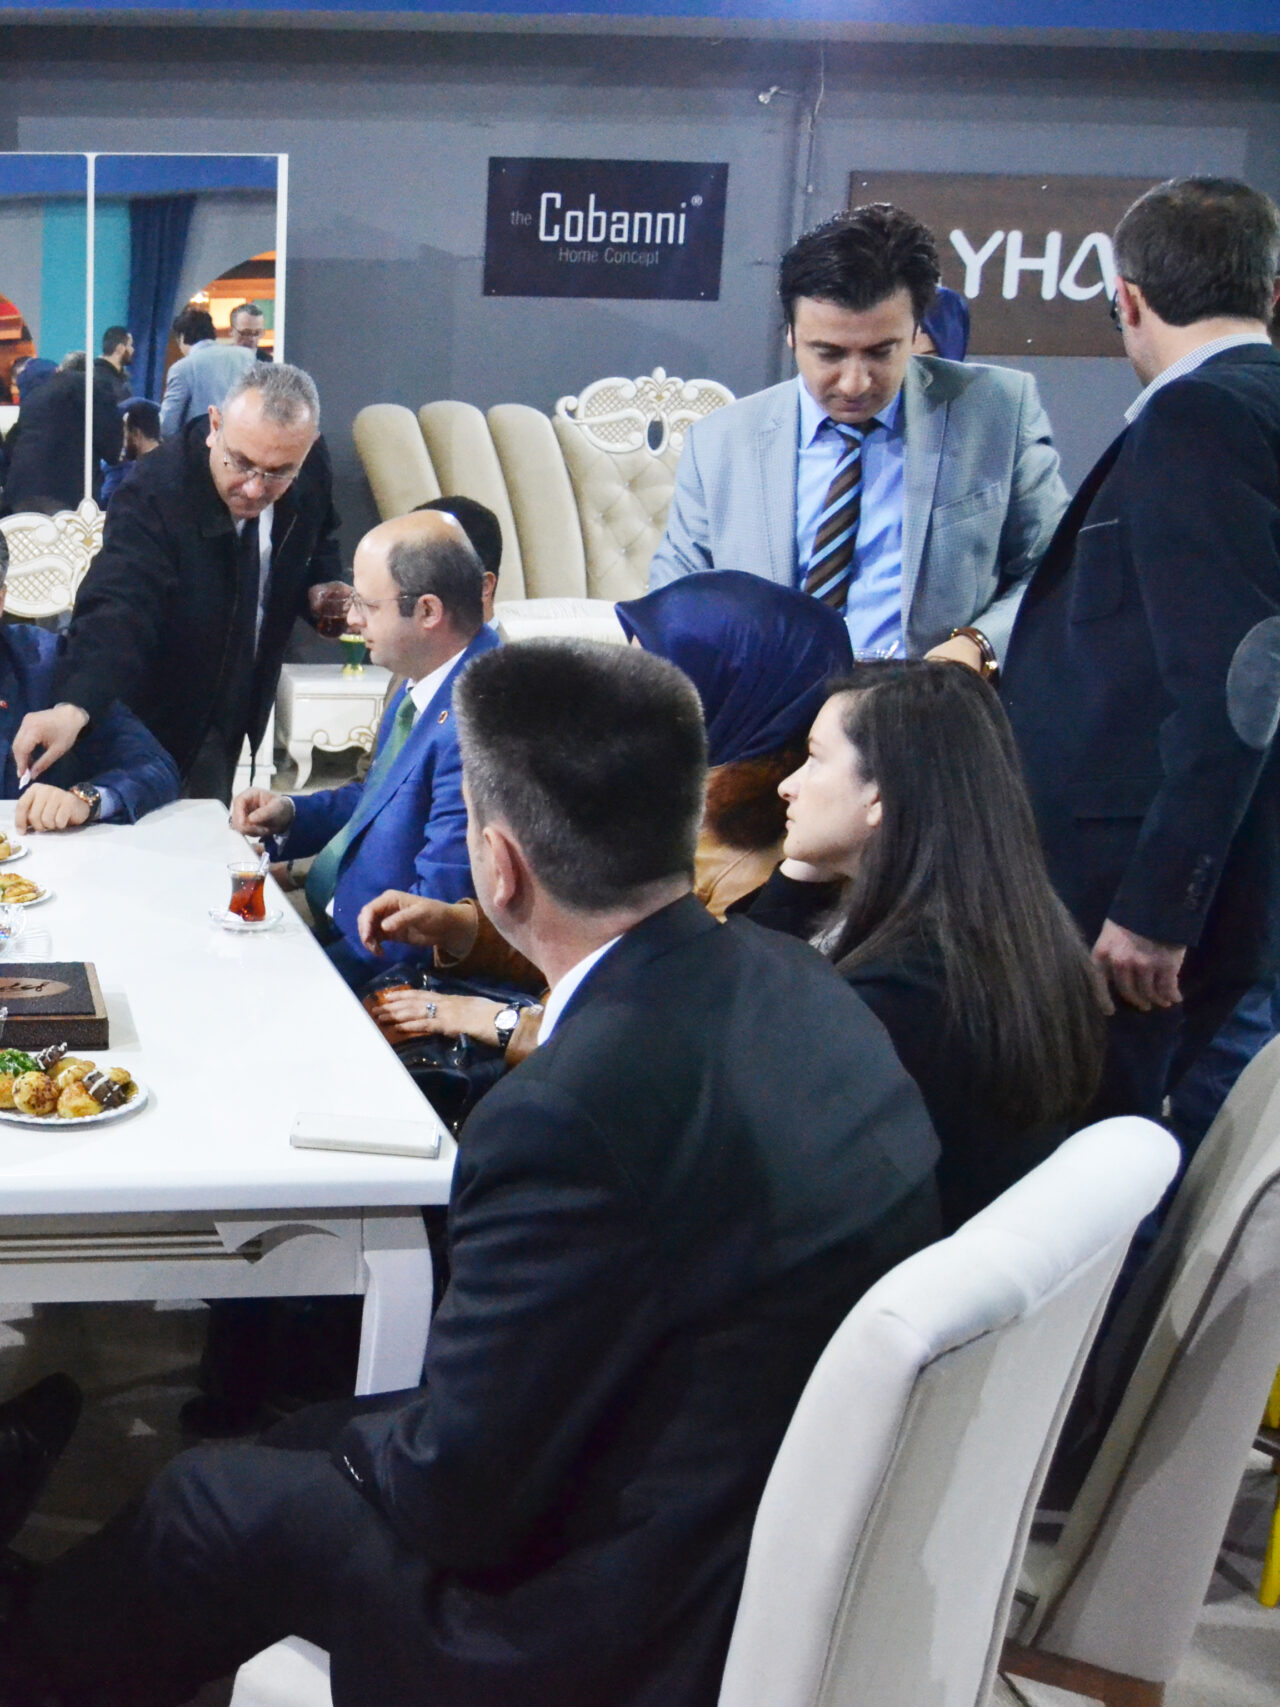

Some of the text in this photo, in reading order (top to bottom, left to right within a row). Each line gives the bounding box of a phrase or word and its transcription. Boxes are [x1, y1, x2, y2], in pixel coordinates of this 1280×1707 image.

[510, 210, 532, 226] the
[558, 247, 660, 266] Home Concept
